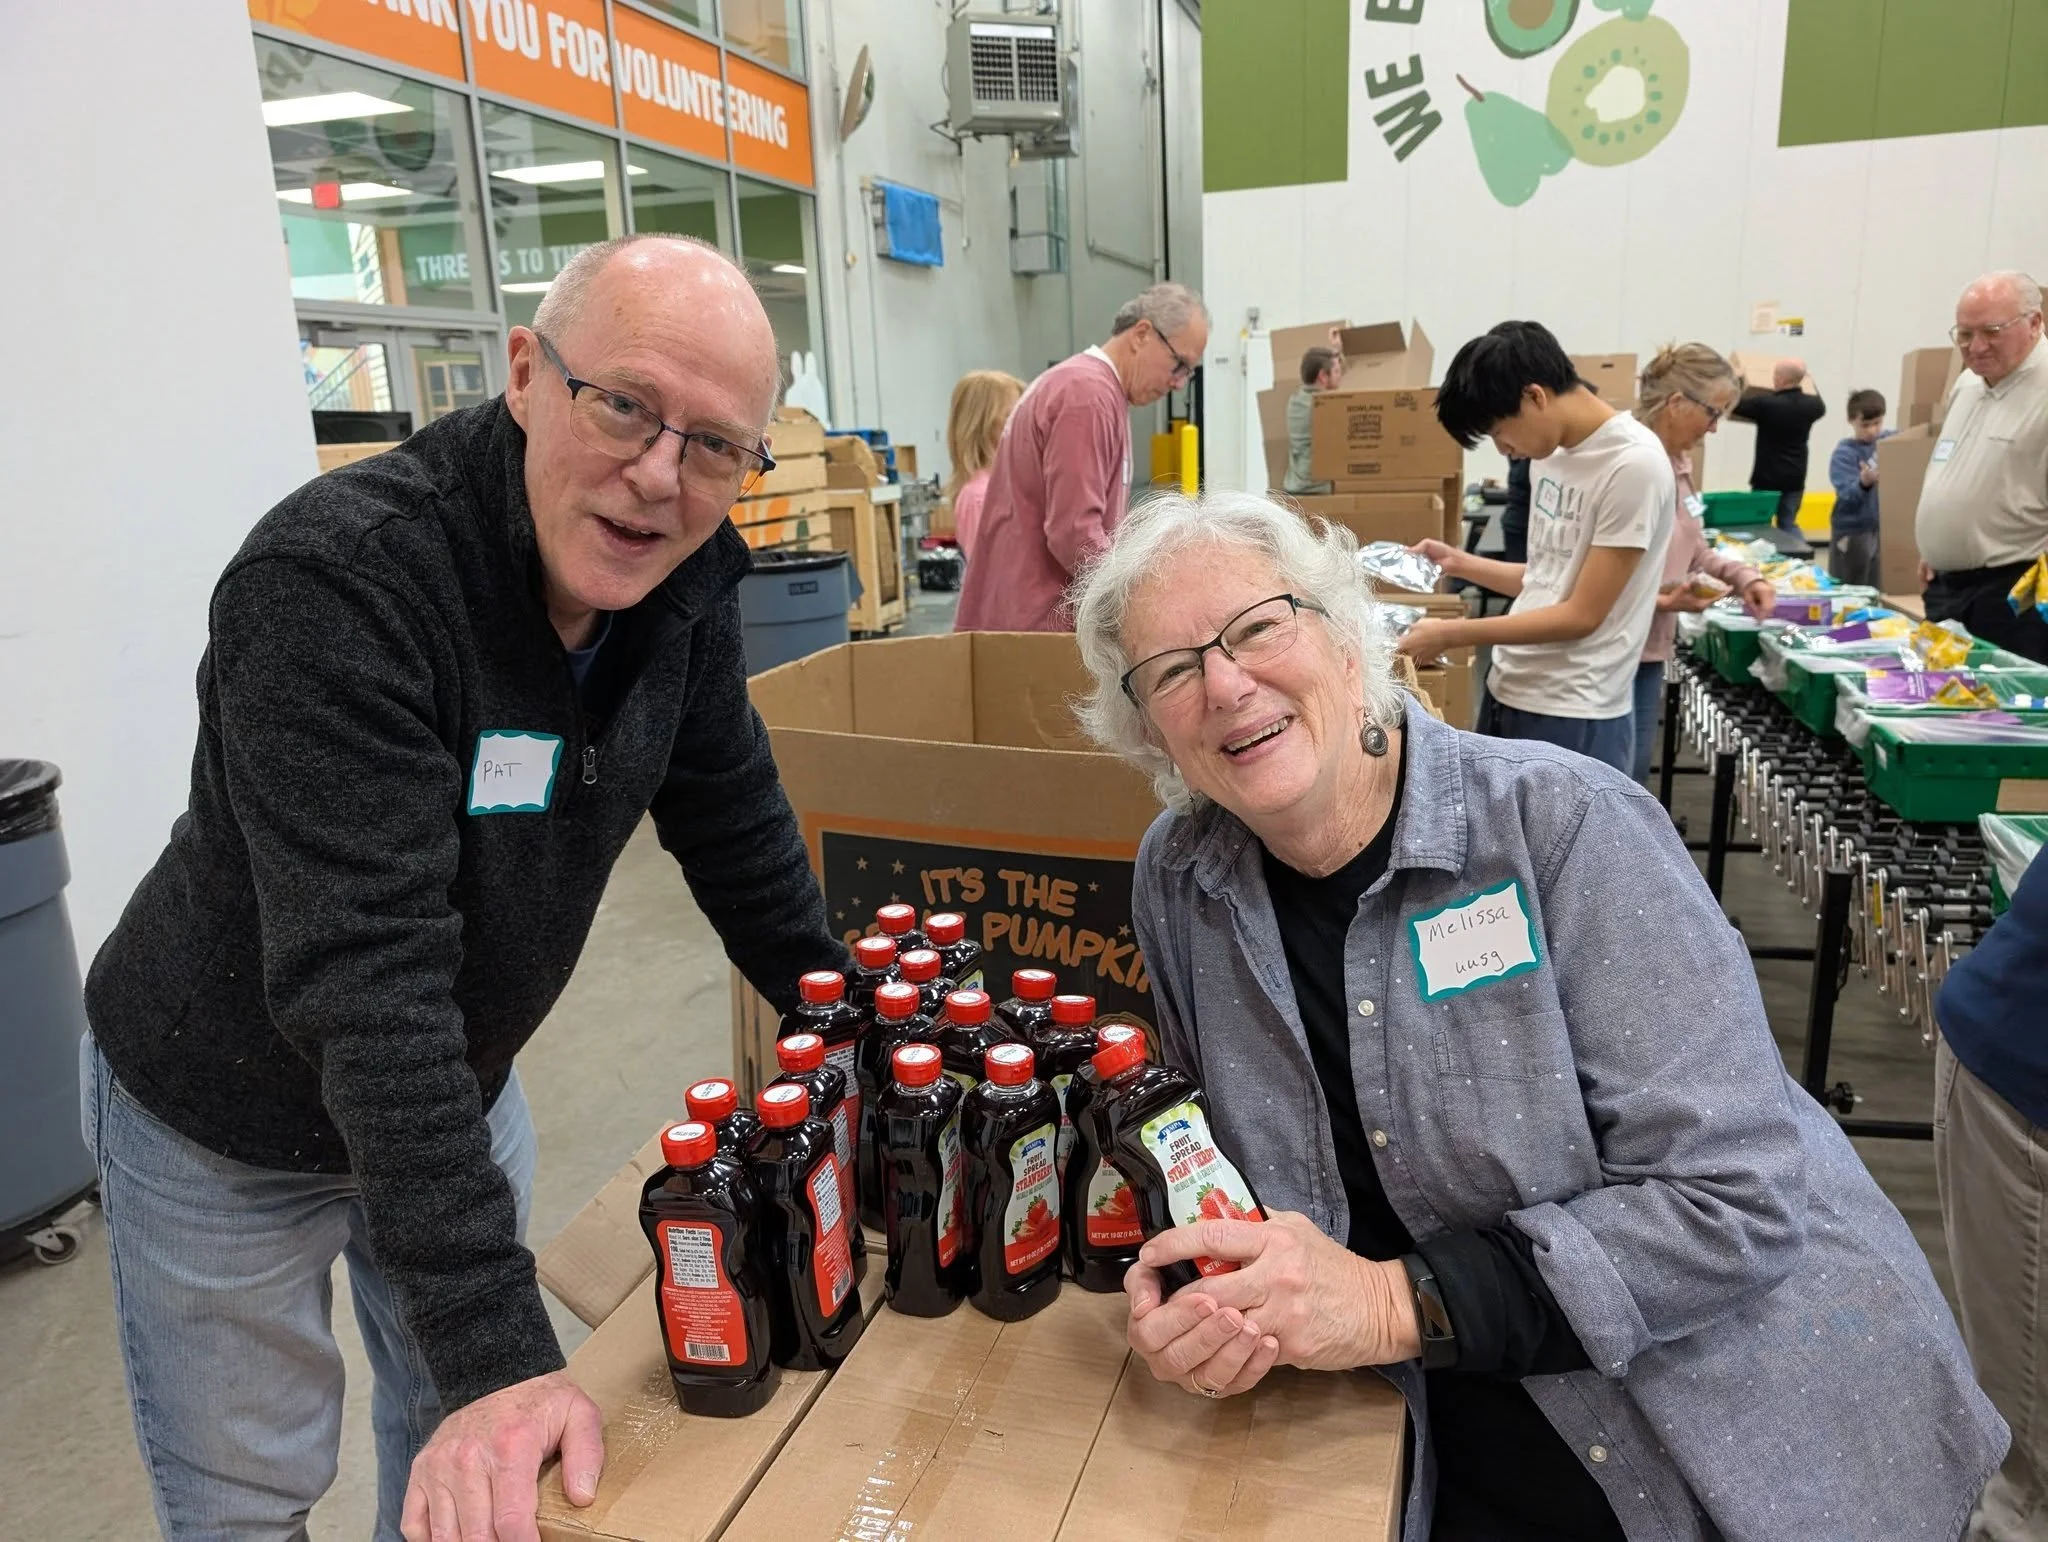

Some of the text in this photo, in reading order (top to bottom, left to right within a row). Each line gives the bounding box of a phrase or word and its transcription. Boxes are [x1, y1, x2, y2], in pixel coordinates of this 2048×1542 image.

[471, 0, 540, 61] YOU
[547, 12, 611, 87] FOR
[612, 40, 788, 149] VOLUNTEERING
[1365, 53, 1443, 163] WE
[517, 248, 544, 274] TO
[483, 760, 522, 784] PAT
[920, 868, 1078, 917] IT'S THE
[1429, 906, 1511, 942] Melissa
[1169, 1133, 1192, 1153] FRUIT
[1170, 1141, 1202, 1164] SPREAD
[1023, 1160, 1047, 1177] SPREAD
[1026, 1152, 1043, 1166] FRUIT
[1203, 1262, 1215, 1274] NET
